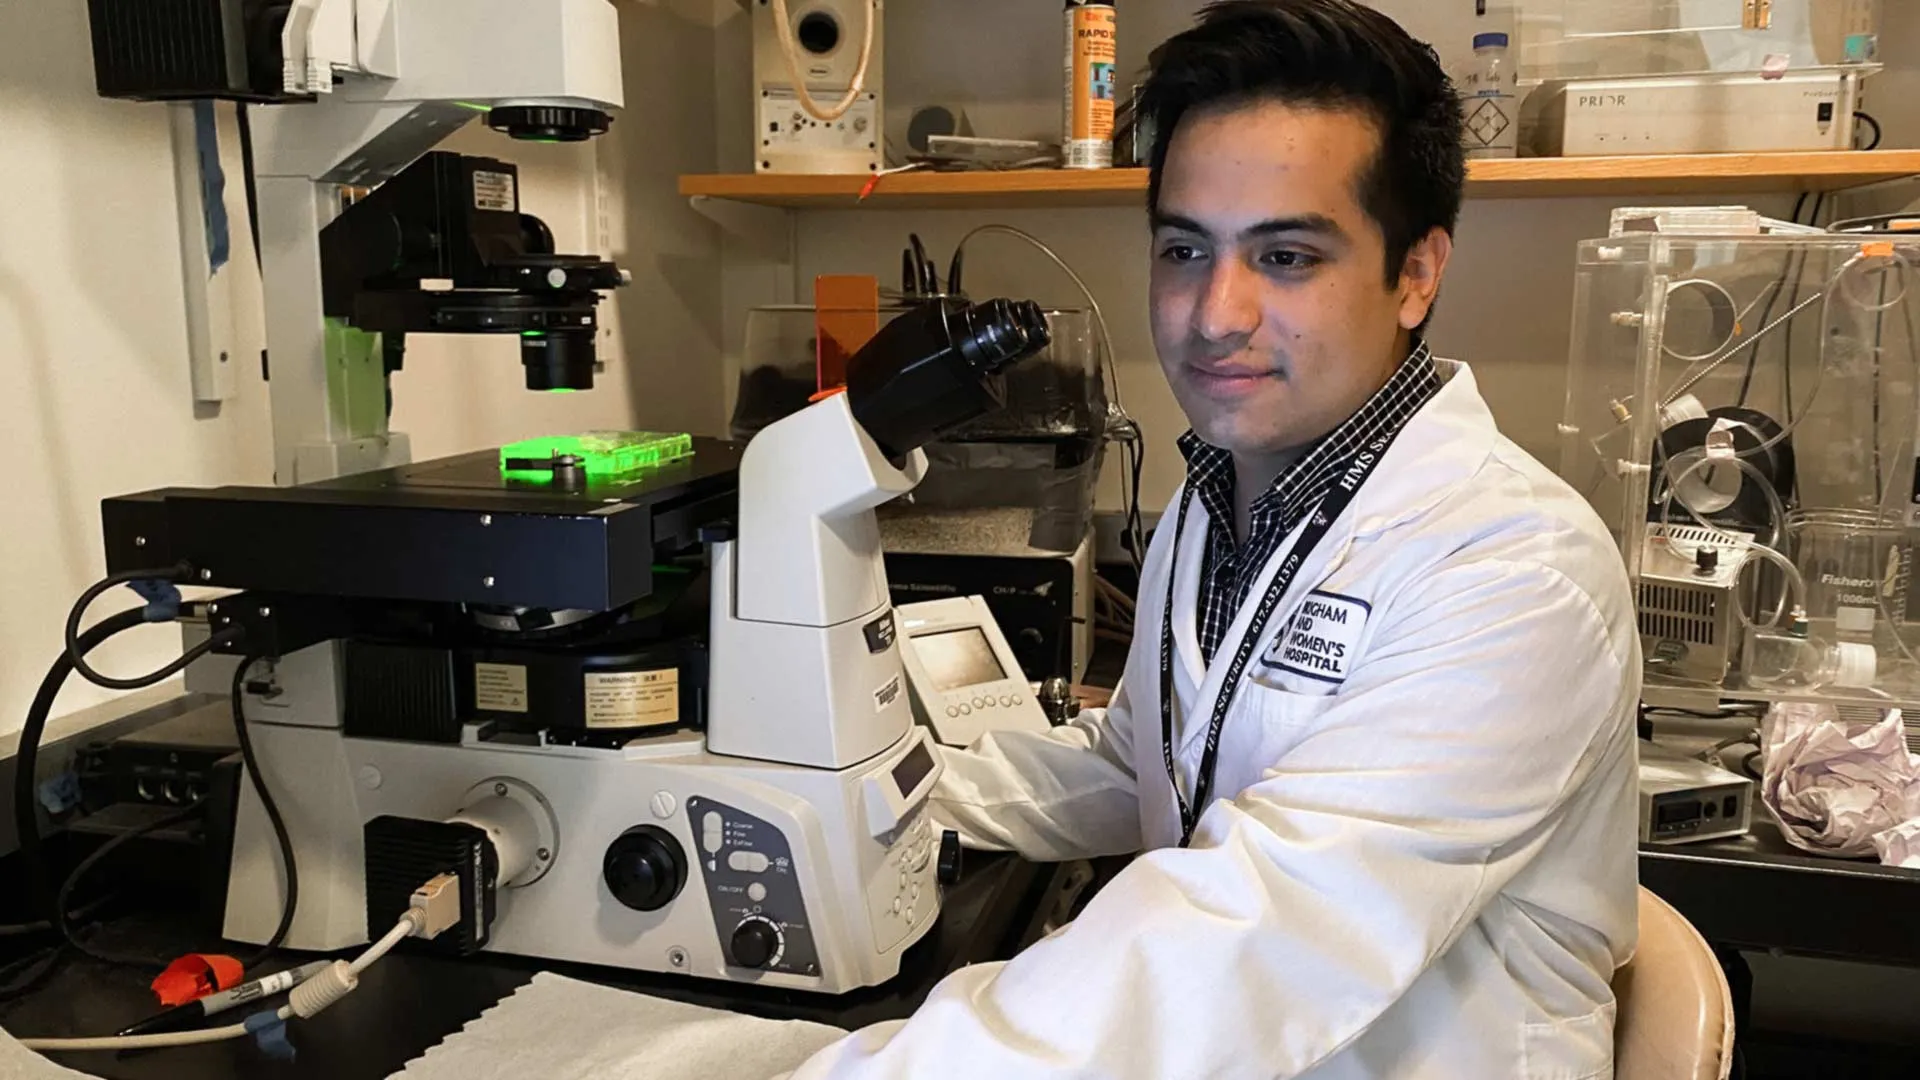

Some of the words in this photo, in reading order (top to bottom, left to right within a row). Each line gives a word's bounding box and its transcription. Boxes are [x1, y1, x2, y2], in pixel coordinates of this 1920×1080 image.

[1078, 29, 1109, 38] RAPID
[1340, 451, 1374, 492] HMS
[1207, 712, 1221, 752] HMS
[1218, 637, 1251, 712] SECURITY
[1252, 554, 1299, 634] 617.432.1379
[1290, 631, 1346, 658] WOMEN'S
[1283, 646, 1342, 673] HOSPITAL
